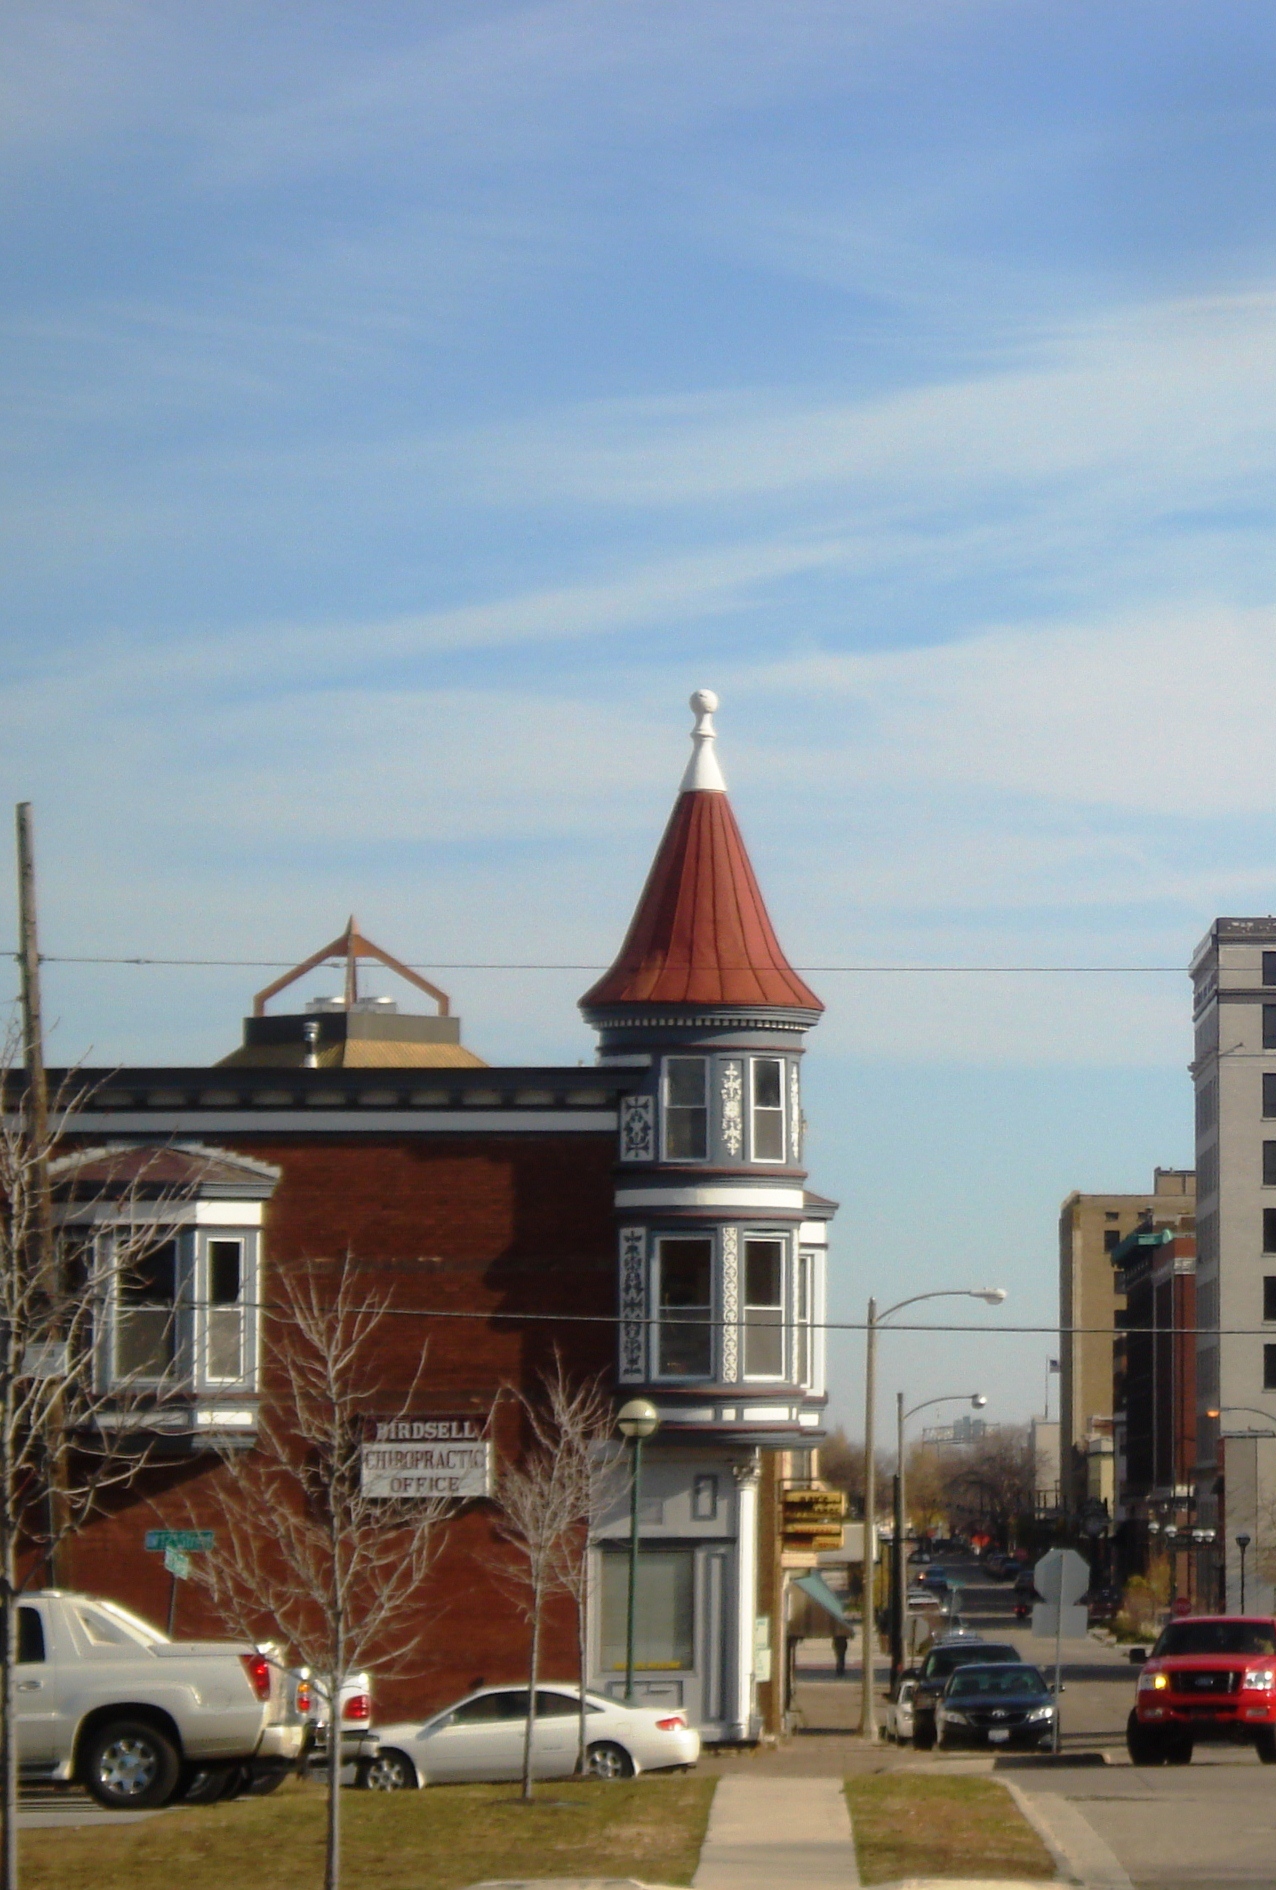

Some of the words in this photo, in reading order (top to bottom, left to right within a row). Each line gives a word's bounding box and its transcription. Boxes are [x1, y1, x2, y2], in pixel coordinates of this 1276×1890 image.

[376, 1421, 476, 1439] BIRDSELL
[364, 1449, 485, 1470] CHIROPRACTIC
[390, 1477, 460, 1493] OFFICE
